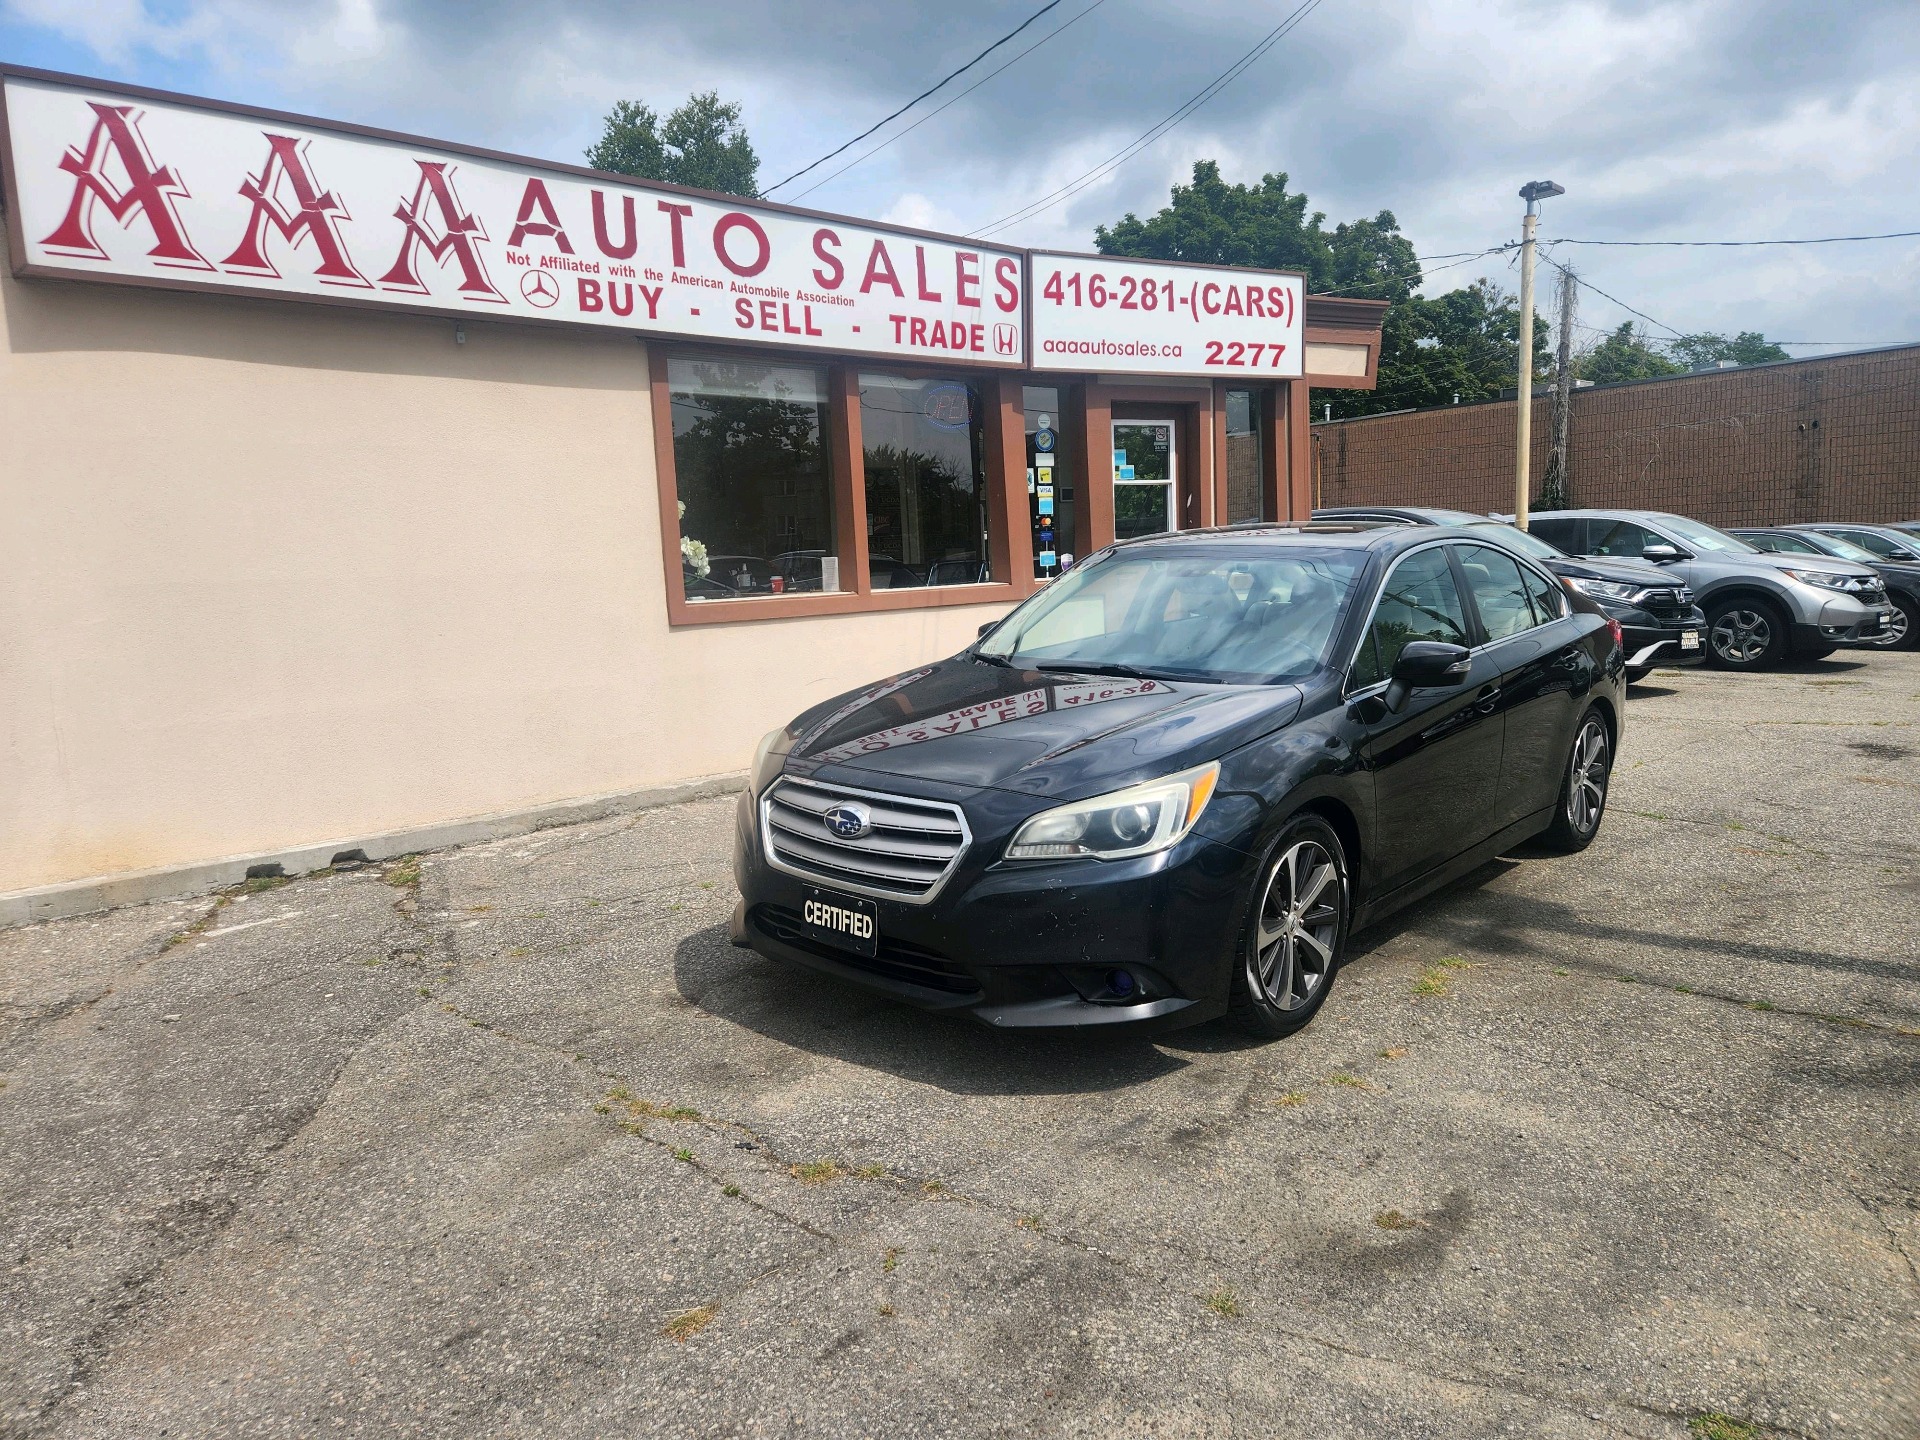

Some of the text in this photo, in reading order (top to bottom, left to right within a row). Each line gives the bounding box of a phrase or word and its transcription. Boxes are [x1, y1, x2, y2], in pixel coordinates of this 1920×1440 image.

[507, 178, 771, 278] AUTO
[812, 229, 1019, 313] SALES
[506, 251, 855, 307] Not Affiliated with the American Automobile Association
[1043, 270, 1294, 328] 416-281-(CARS)
[577, 278, 664, 320] BUY
[735, 298, 823, 337] SELL
[888, 314, 985, 353] TRADE
[1043, 339, 1287, 368] aaaautosales.ca 2277
[924, 394, 976, 419] OPEN
[804, 899, 874, 940] CERTIFIED
